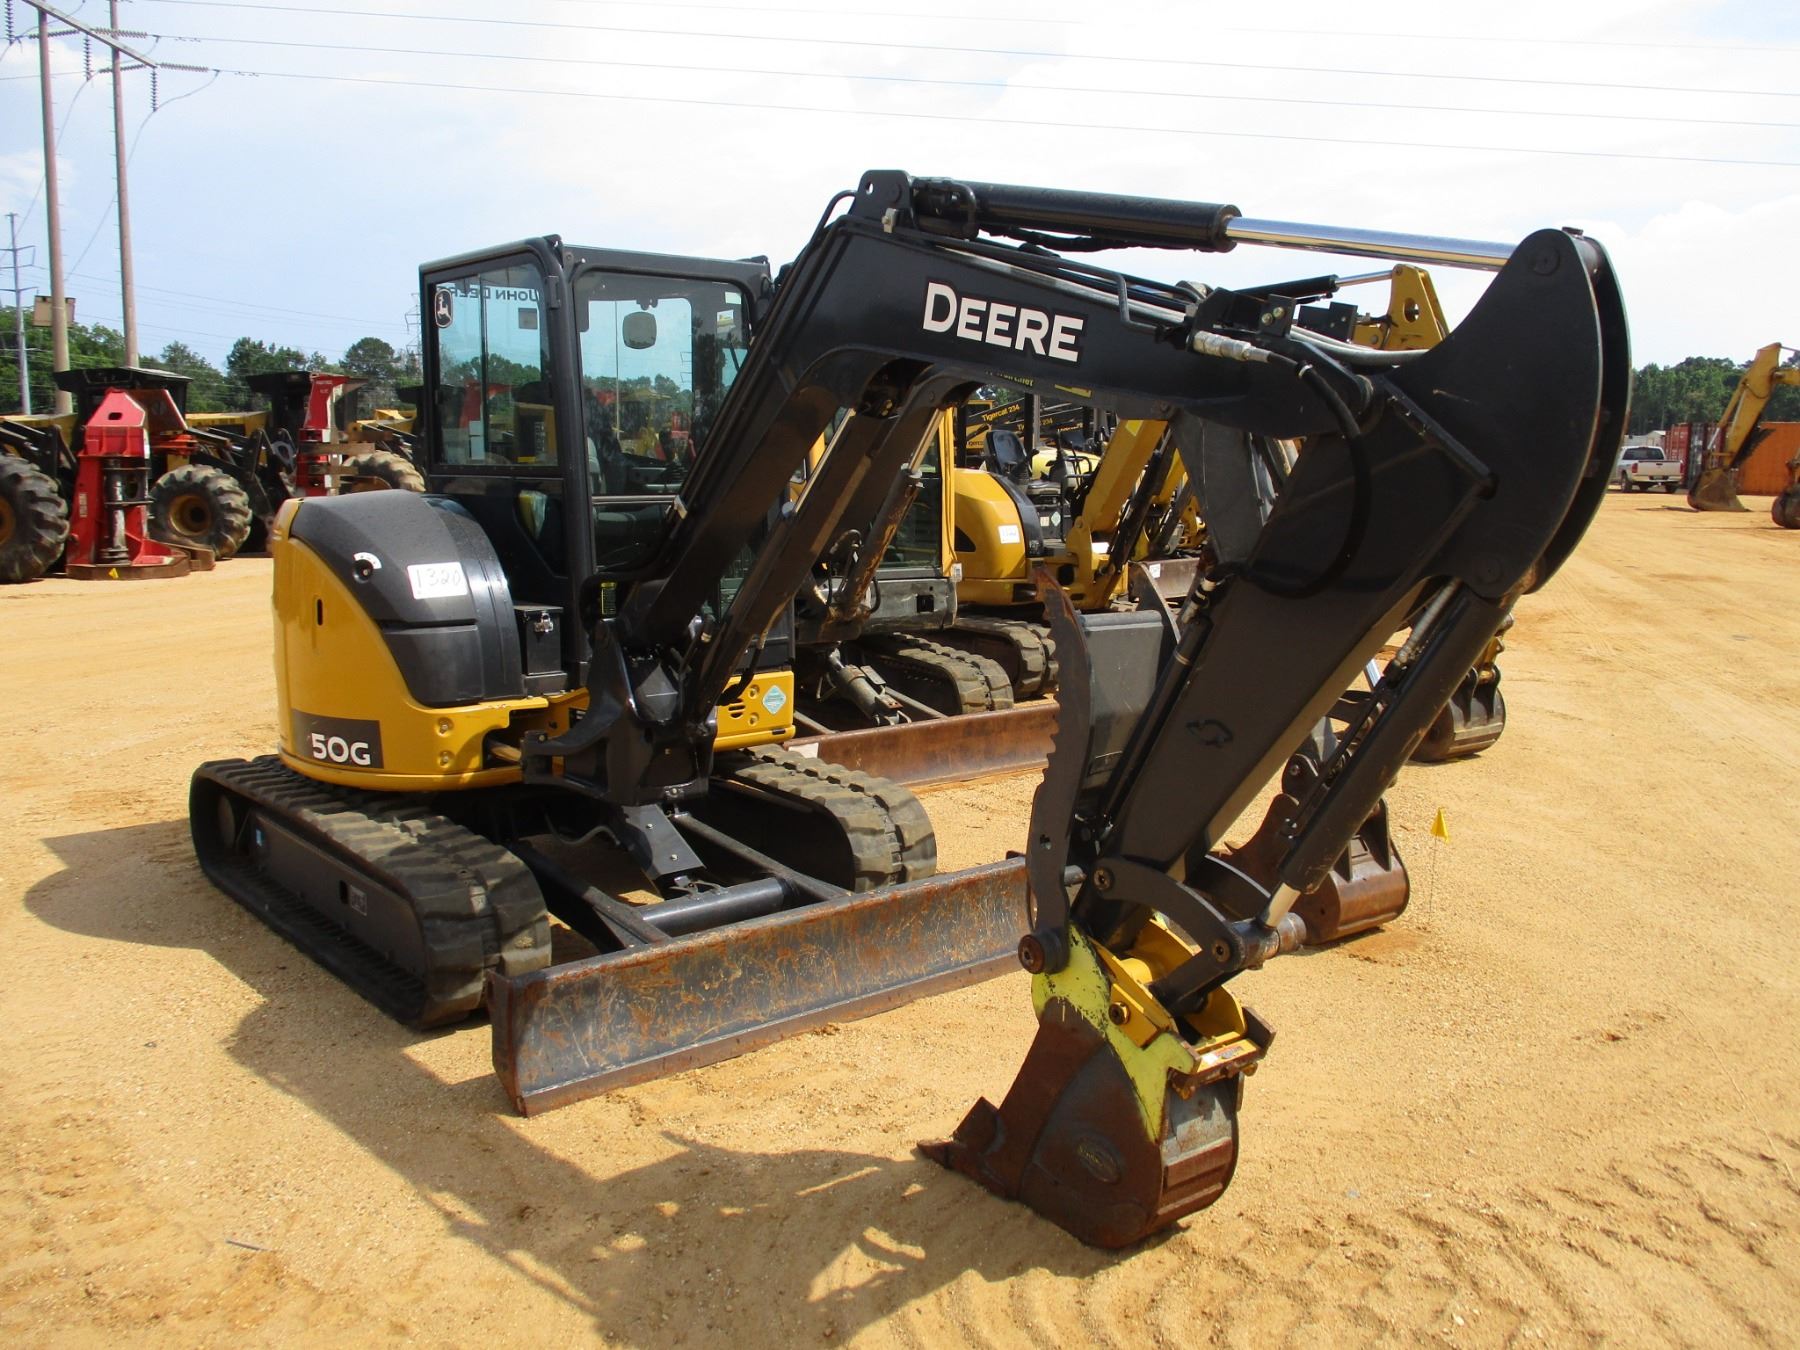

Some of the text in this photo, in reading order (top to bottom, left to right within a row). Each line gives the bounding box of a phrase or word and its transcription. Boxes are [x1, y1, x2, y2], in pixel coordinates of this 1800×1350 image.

[922, 281, 1084, 363] DEERE
[416, 567, 462, 589] 1320
[311, 732, 371, 766] 50G
